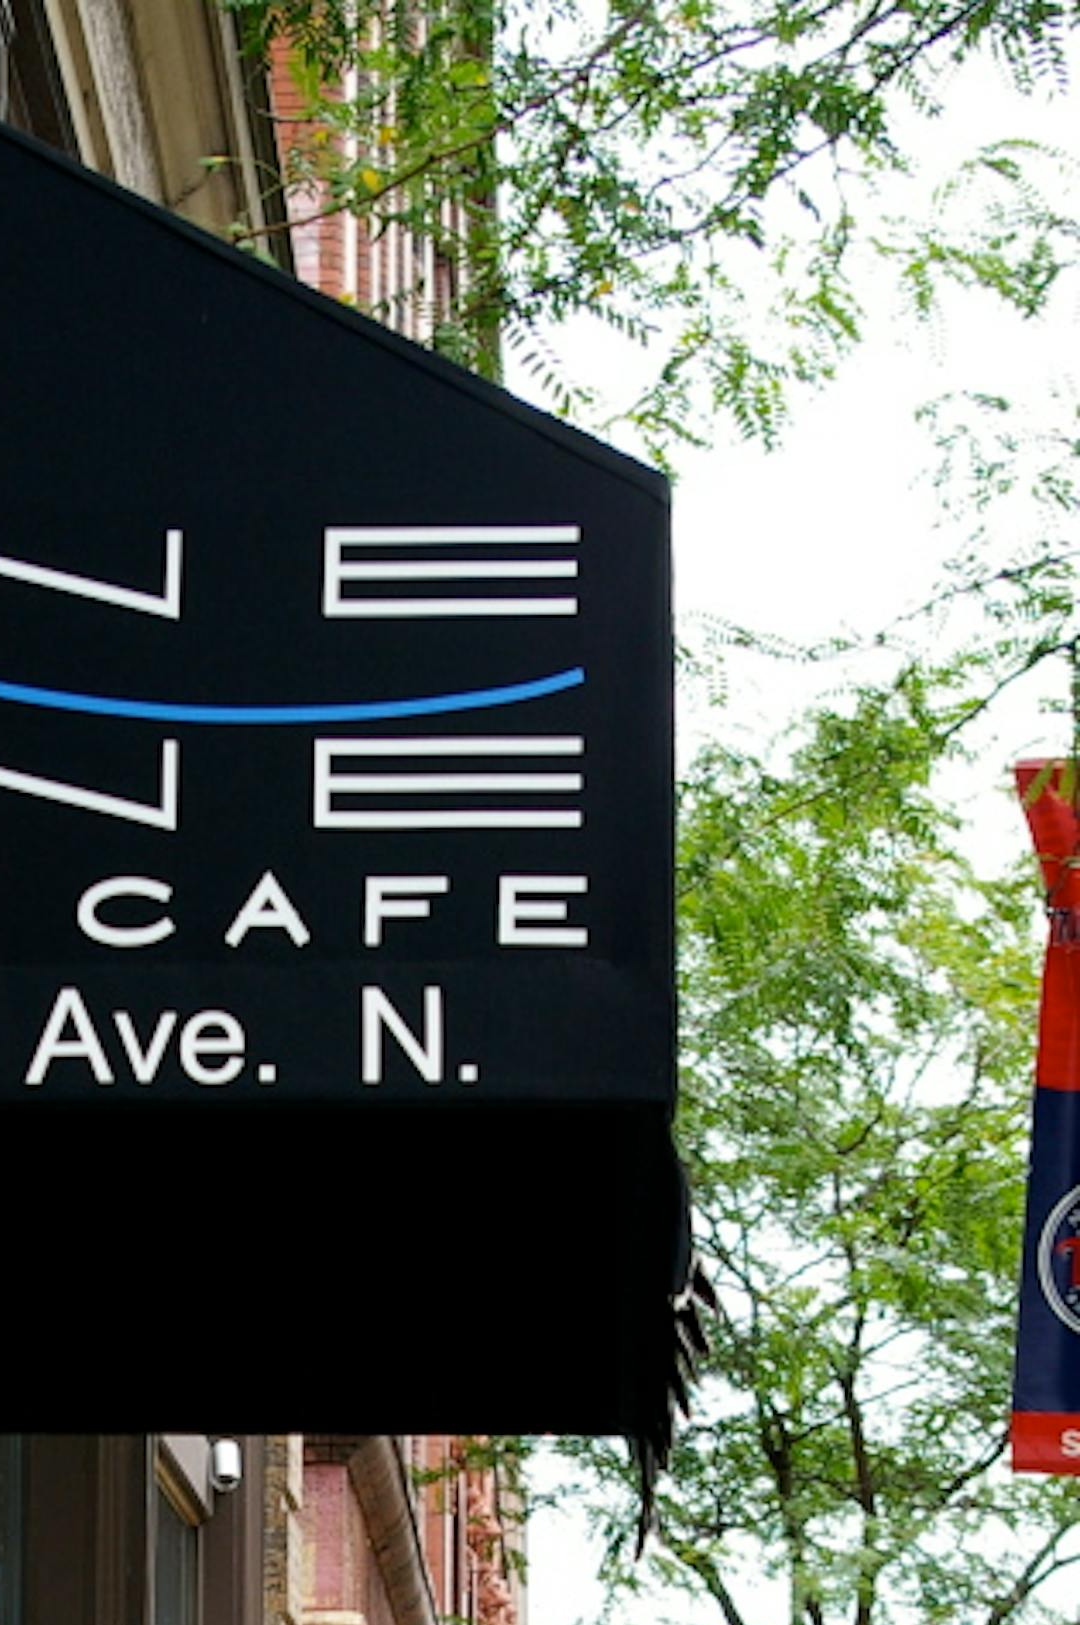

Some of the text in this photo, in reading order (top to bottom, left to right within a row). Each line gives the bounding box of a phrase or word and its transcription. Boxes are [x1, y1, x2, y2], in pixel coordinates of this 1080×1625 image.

[77, 871, 588, 947] CAFE
[25, 988, 276, 1085] Ave.
[362, 986, 478, 1084] N.
